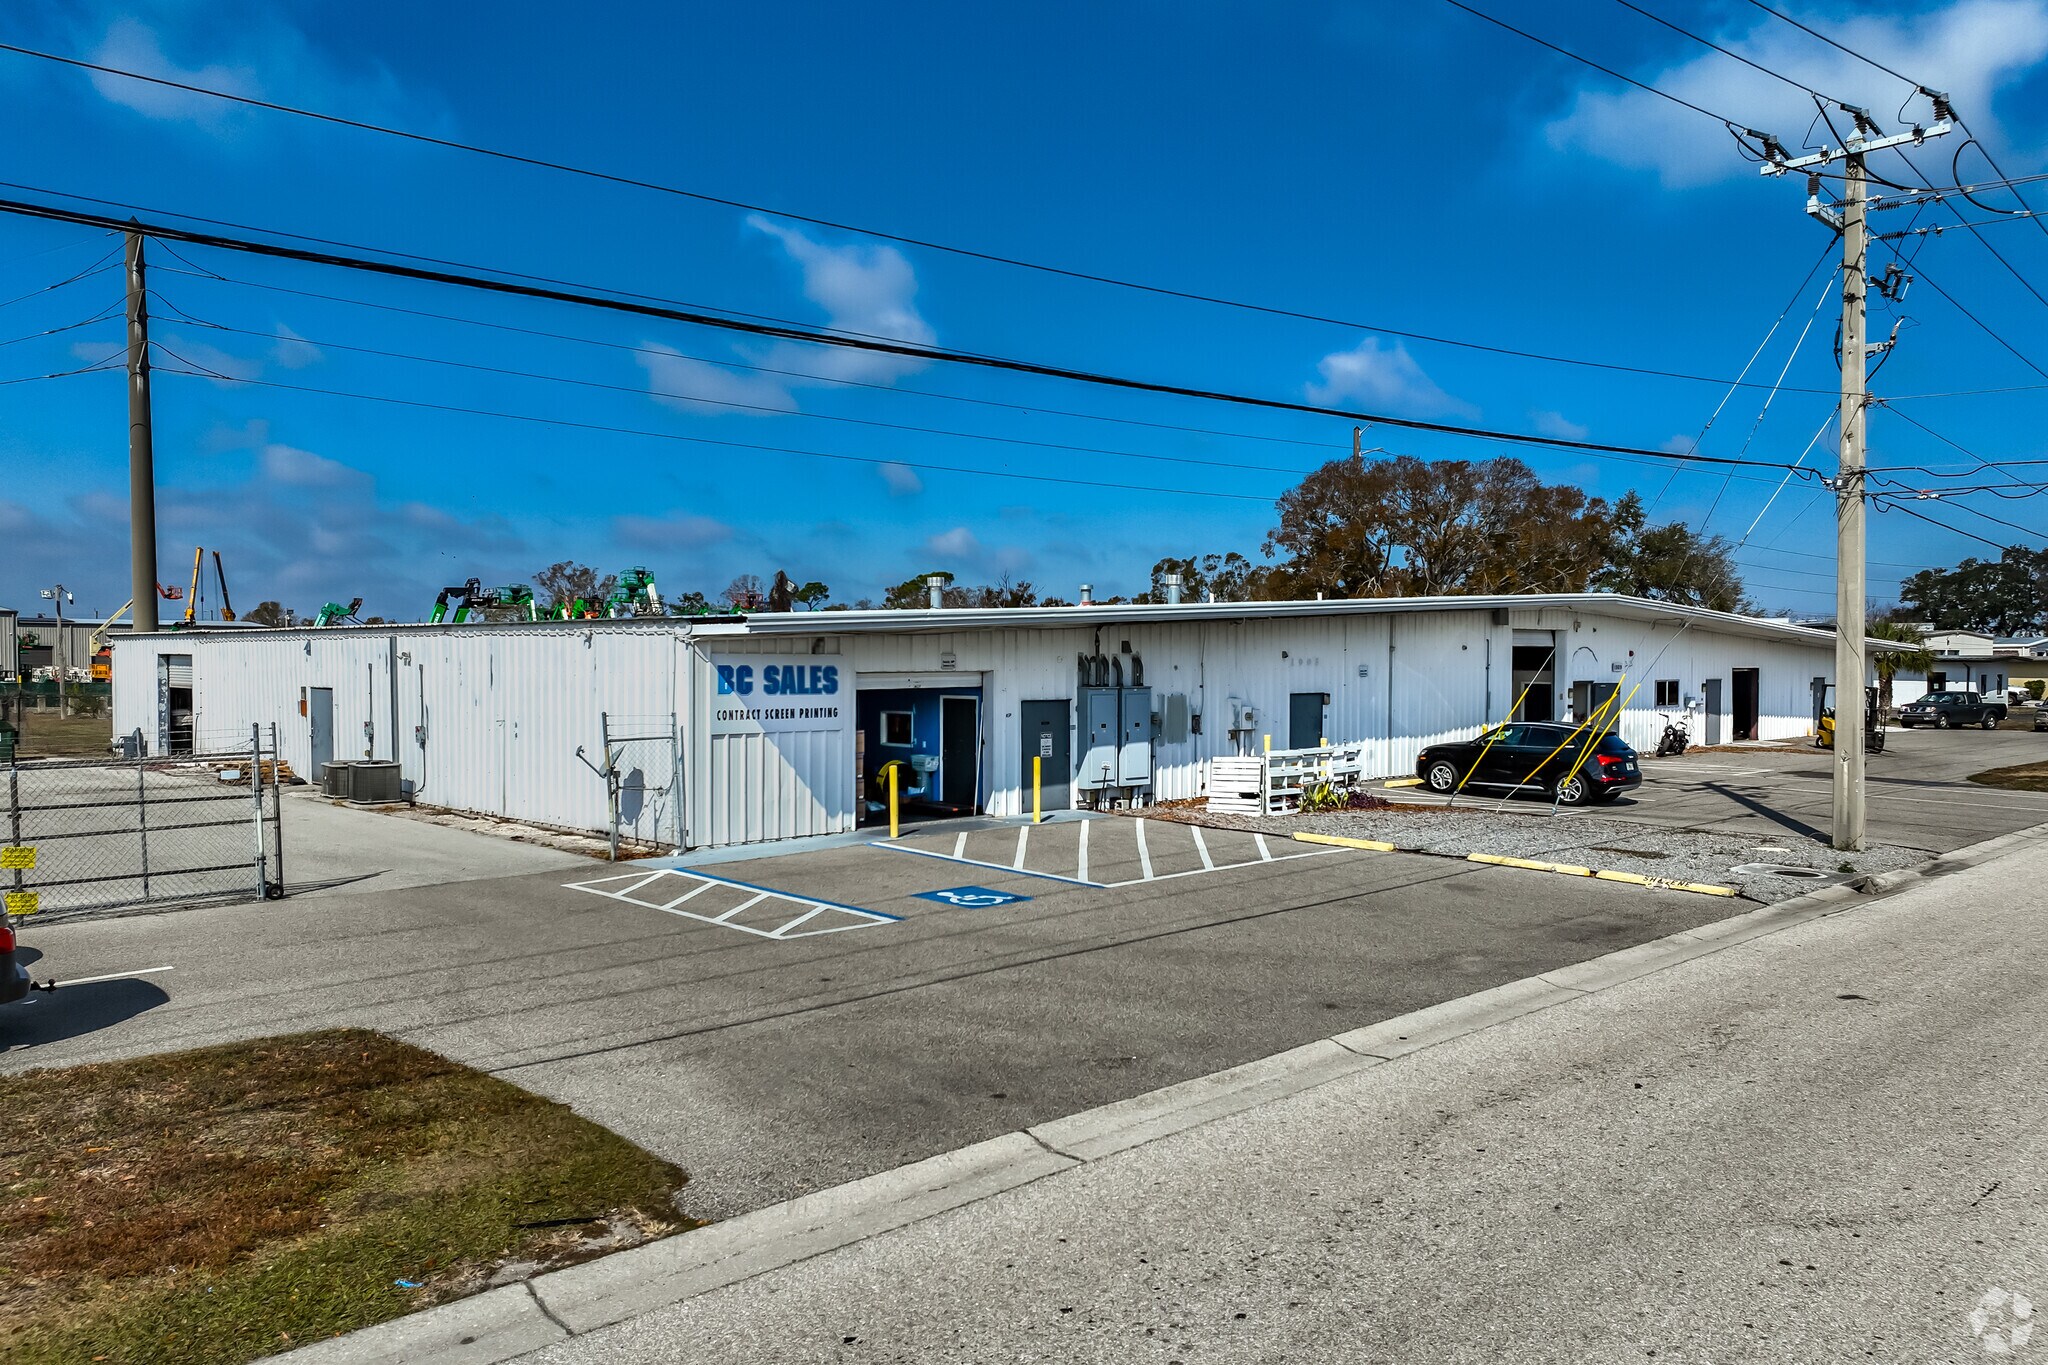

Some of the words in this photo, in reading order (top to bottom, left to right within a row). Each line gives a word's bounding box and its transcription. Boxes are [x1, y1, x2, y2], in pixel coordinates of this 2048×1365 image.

[716, 664, 754, 696] BC
[763, 664, 839, 696] SALES
[716, 708, 761, 722] CONTRACT
[764, 708, 795, 721] SCREEN
[799, 707, 839, 719] PRINTING
